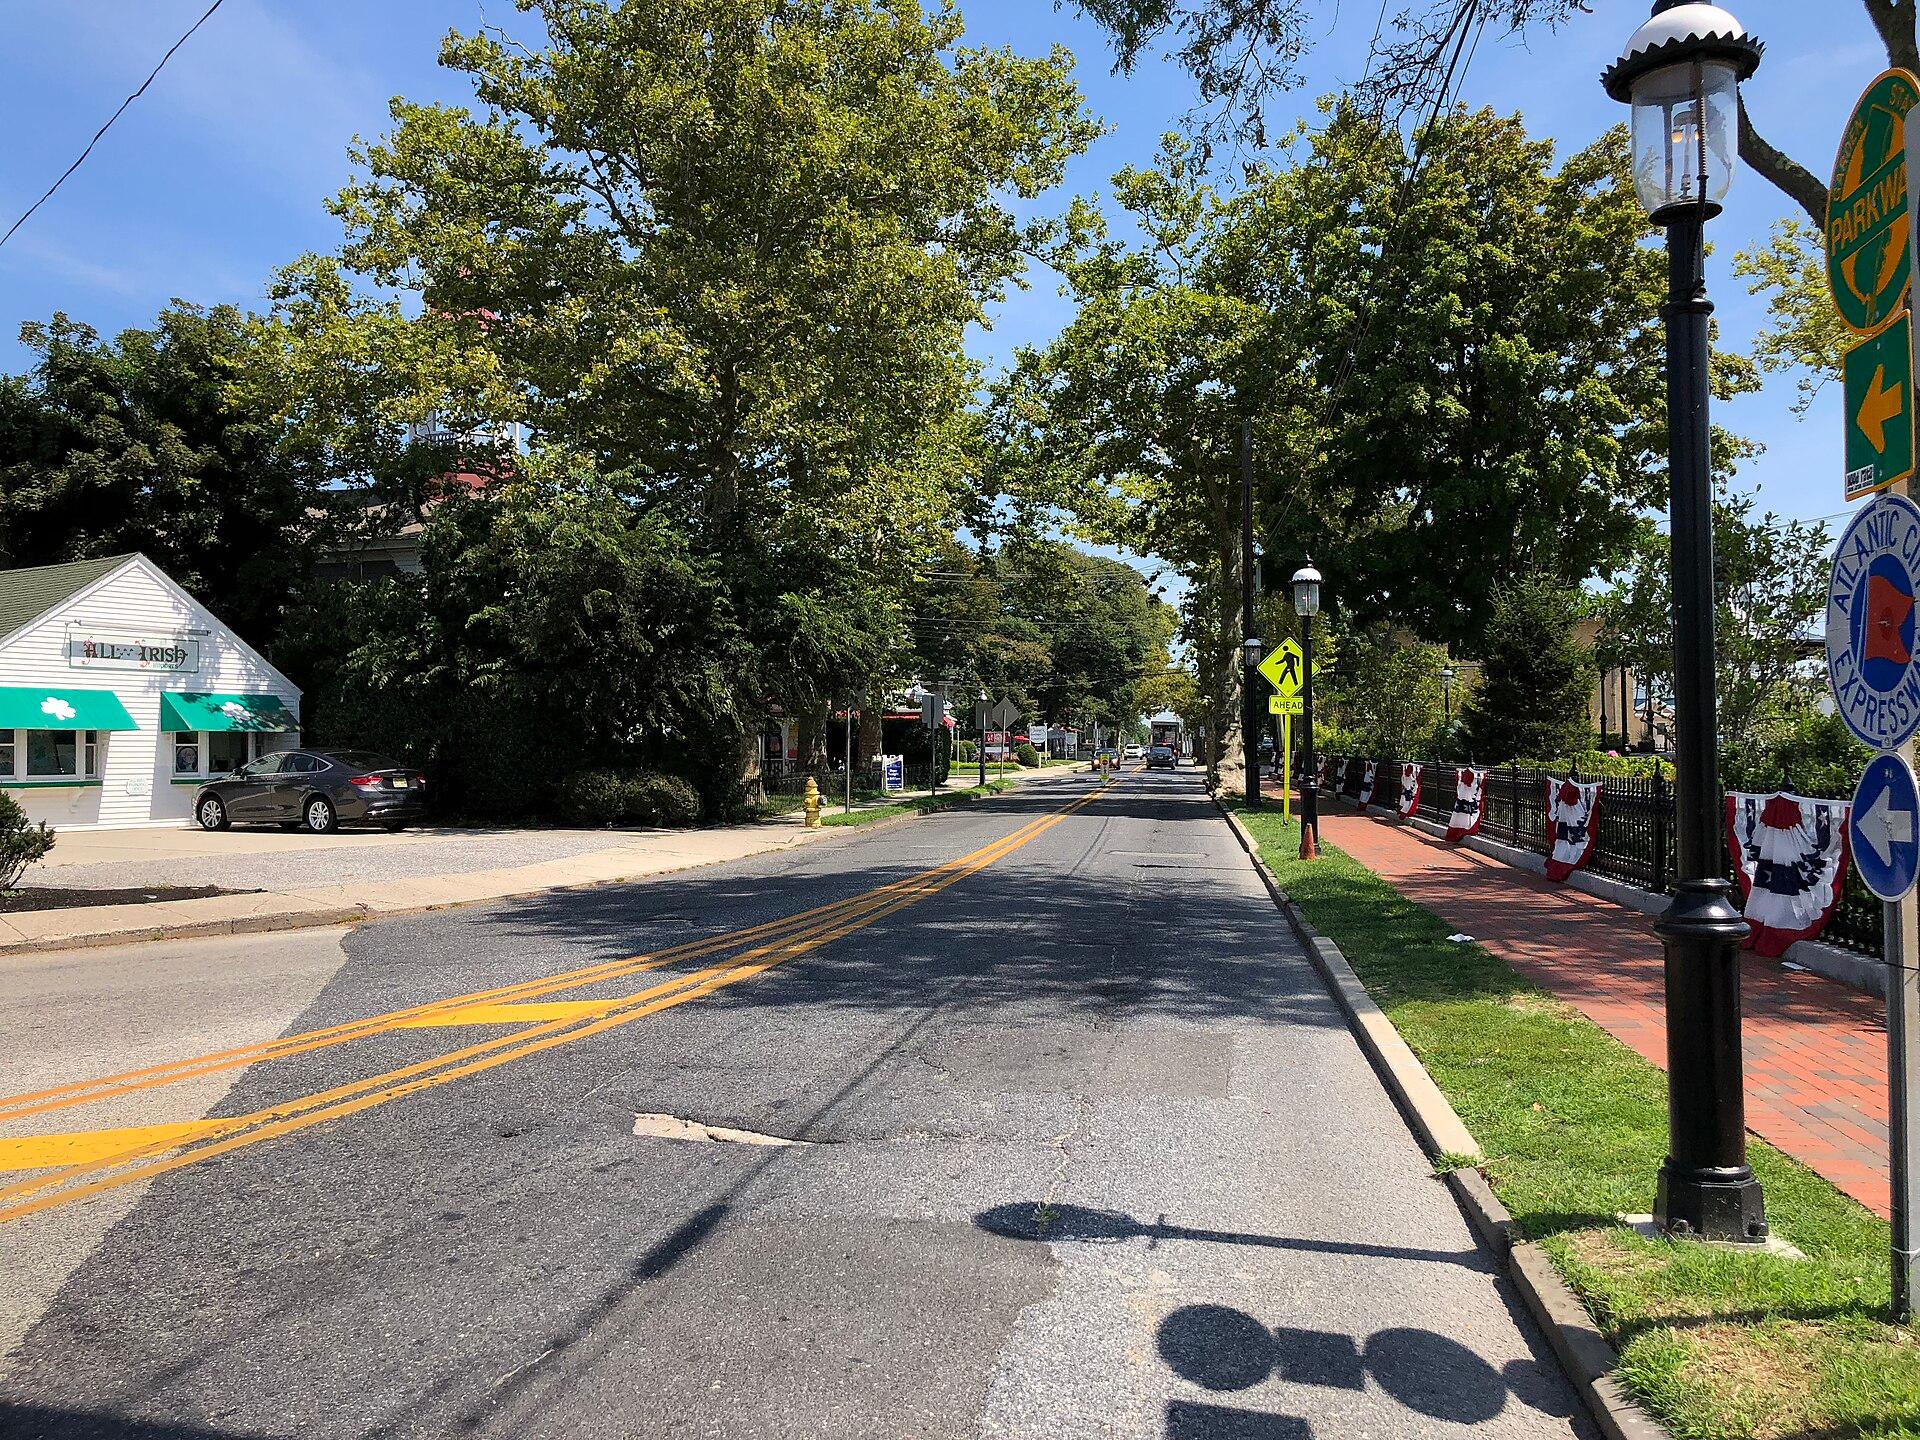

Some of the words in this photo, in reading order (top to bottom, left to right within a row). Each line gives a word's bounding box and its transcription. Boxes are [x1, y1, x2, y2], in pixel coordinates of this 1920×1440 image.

[1833, 510, 1900, 614] ATLANTIC
[82, 636, 121, 664] ALL
[1274, 701, 1303, 709] AHEAD
[1835, 649, 1920, 735] EXPRESSW
